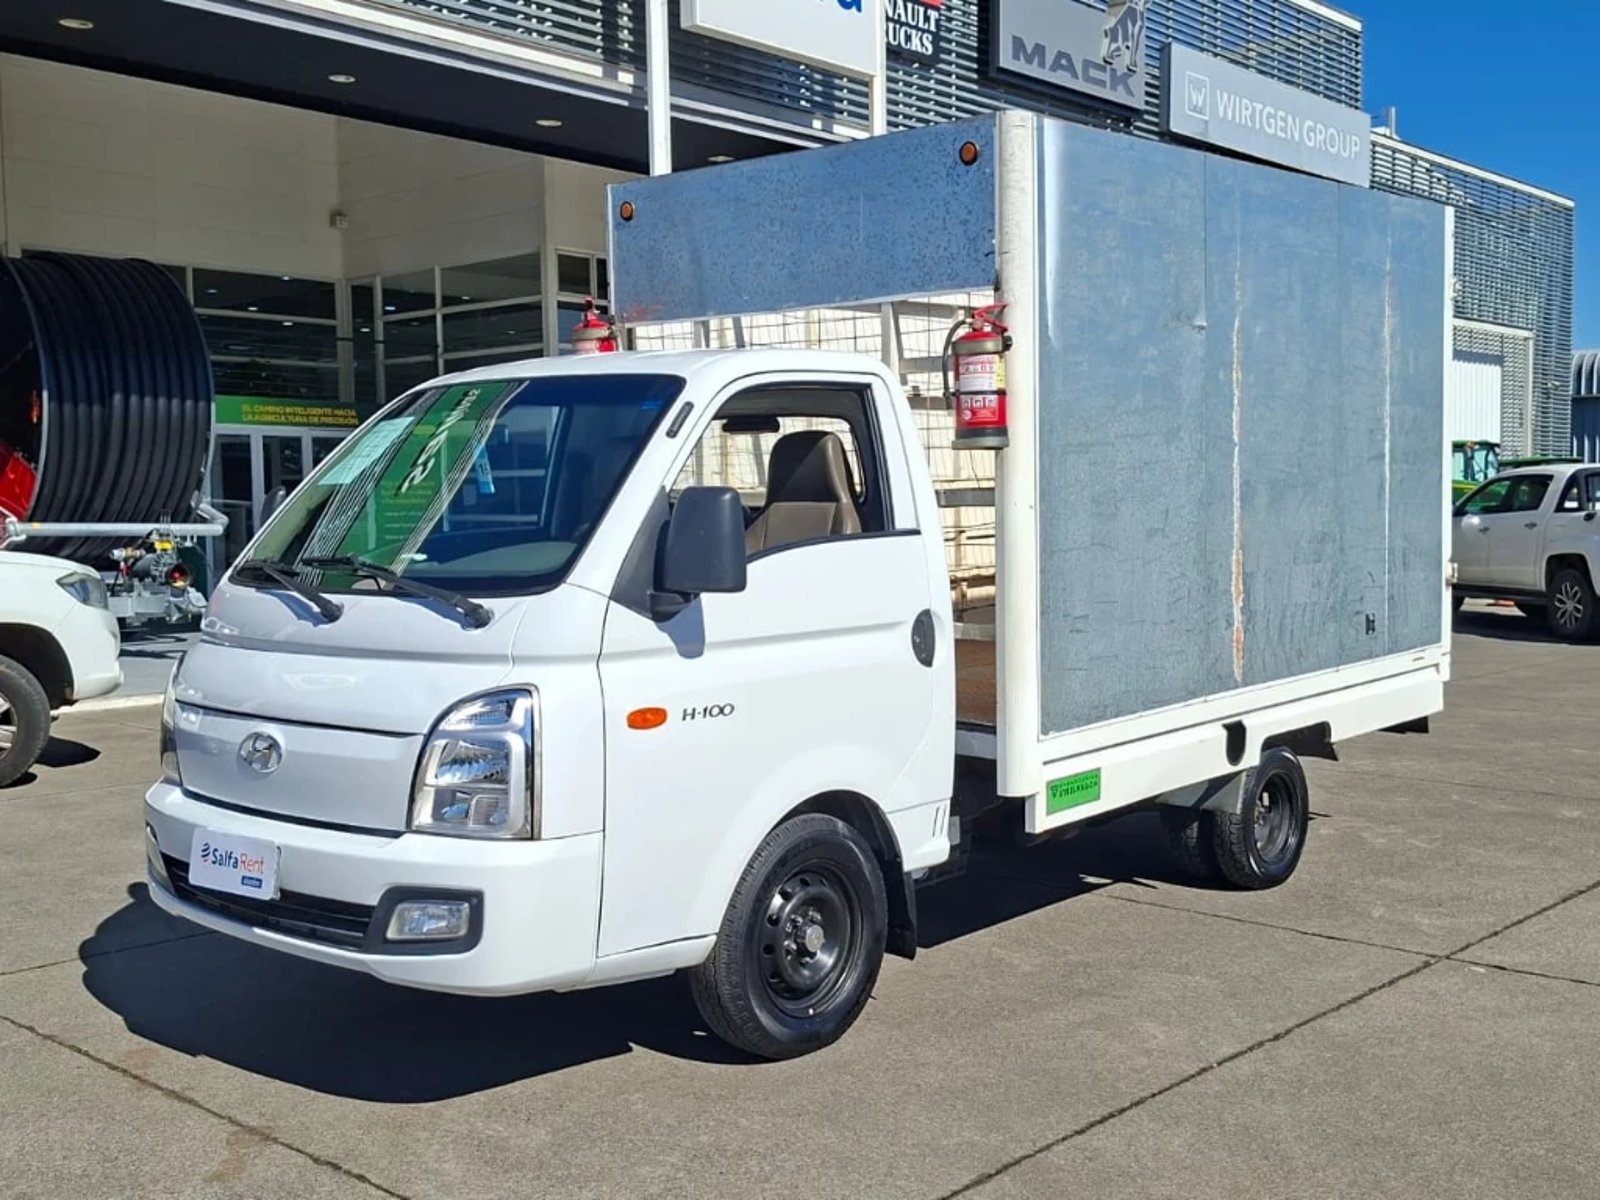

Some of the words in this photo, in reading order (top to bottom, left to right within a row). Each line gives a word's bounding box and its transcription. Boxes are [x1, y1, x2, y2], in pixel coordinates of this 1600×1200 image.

[886, 18, 933, 56] UCKS
[1011, 35, 1135, 98] MACK
[1216, 89, 1299, 143] WIRTGEN
[1303, 119, 1361, 161] GROUP
[682, 703, 735, 721] H-100
